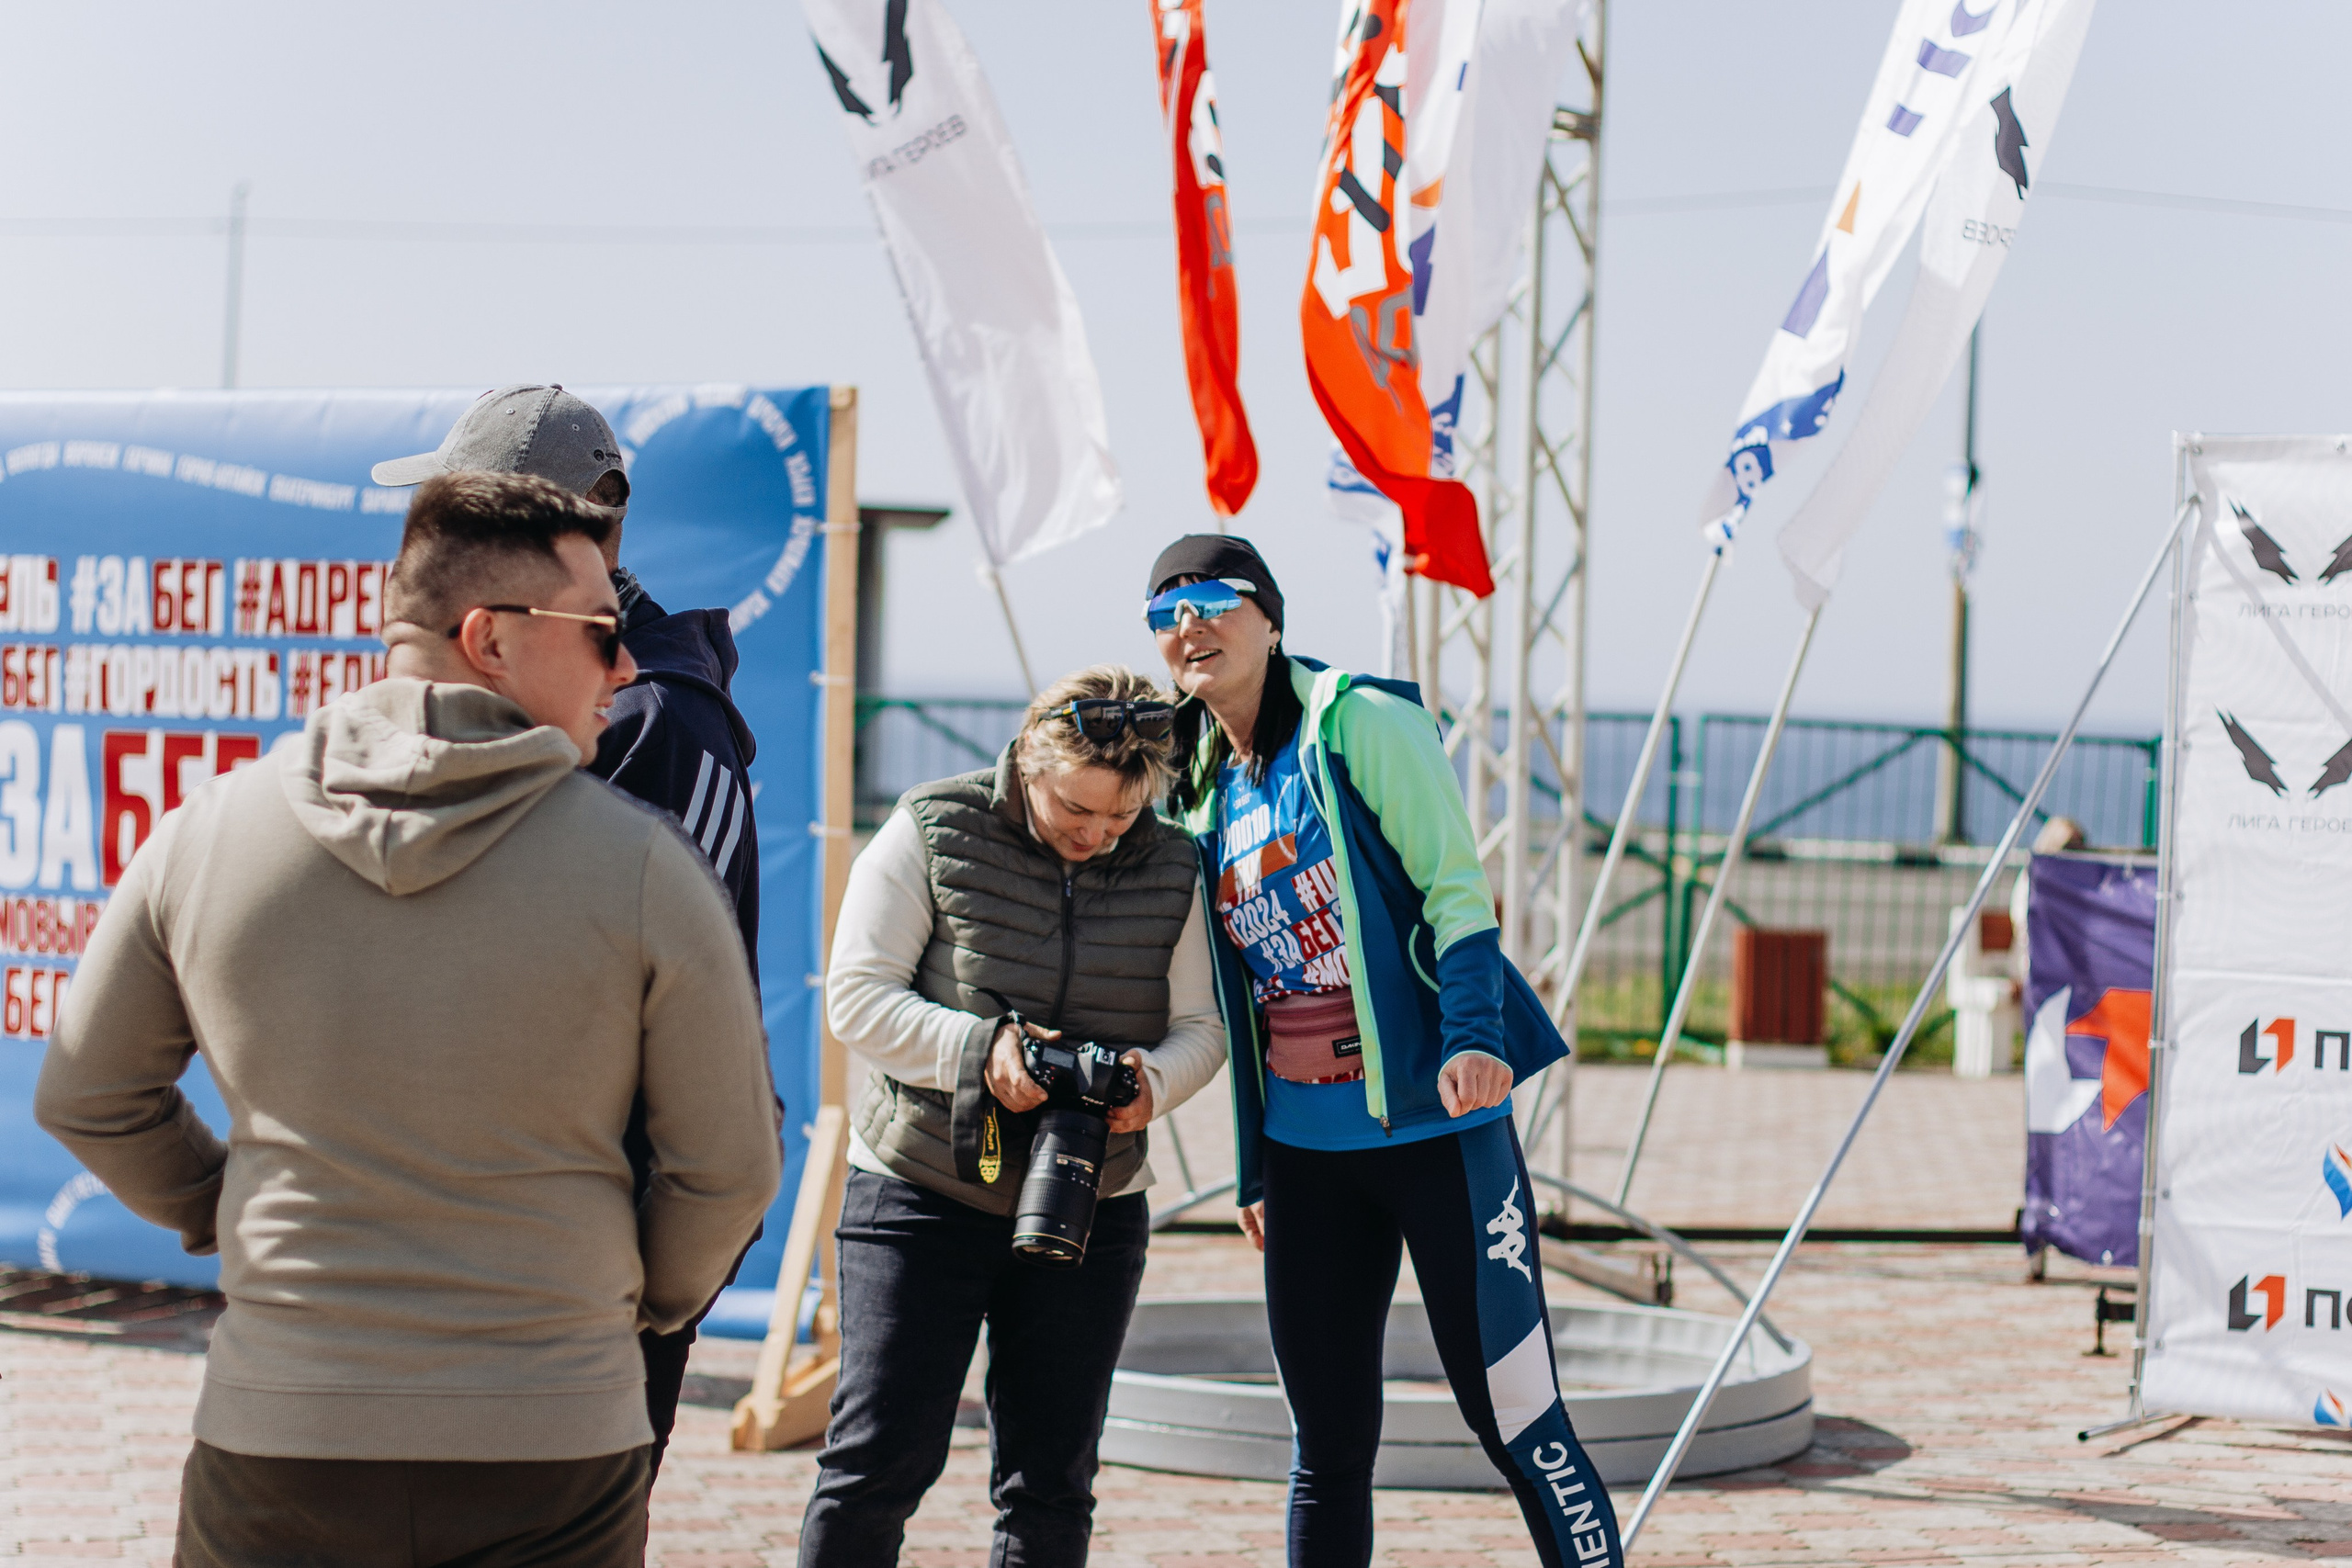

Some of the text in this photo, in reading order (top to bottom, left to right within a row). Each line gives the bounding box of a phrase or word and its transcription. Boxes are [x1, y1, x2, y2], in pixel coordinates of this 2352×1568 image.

[70, 554, 226, 636] #ЗАБЕГ
[237, 559, 390, 636] #АДРЕ
[2239, 602, 2290, 618] ЛИГА
[65, 643, 280, 720] #ГОРДОСТЬ
[1223, 803, 1271, 864] 20010
[2228, 813, 2280, 829] ЛИГА
